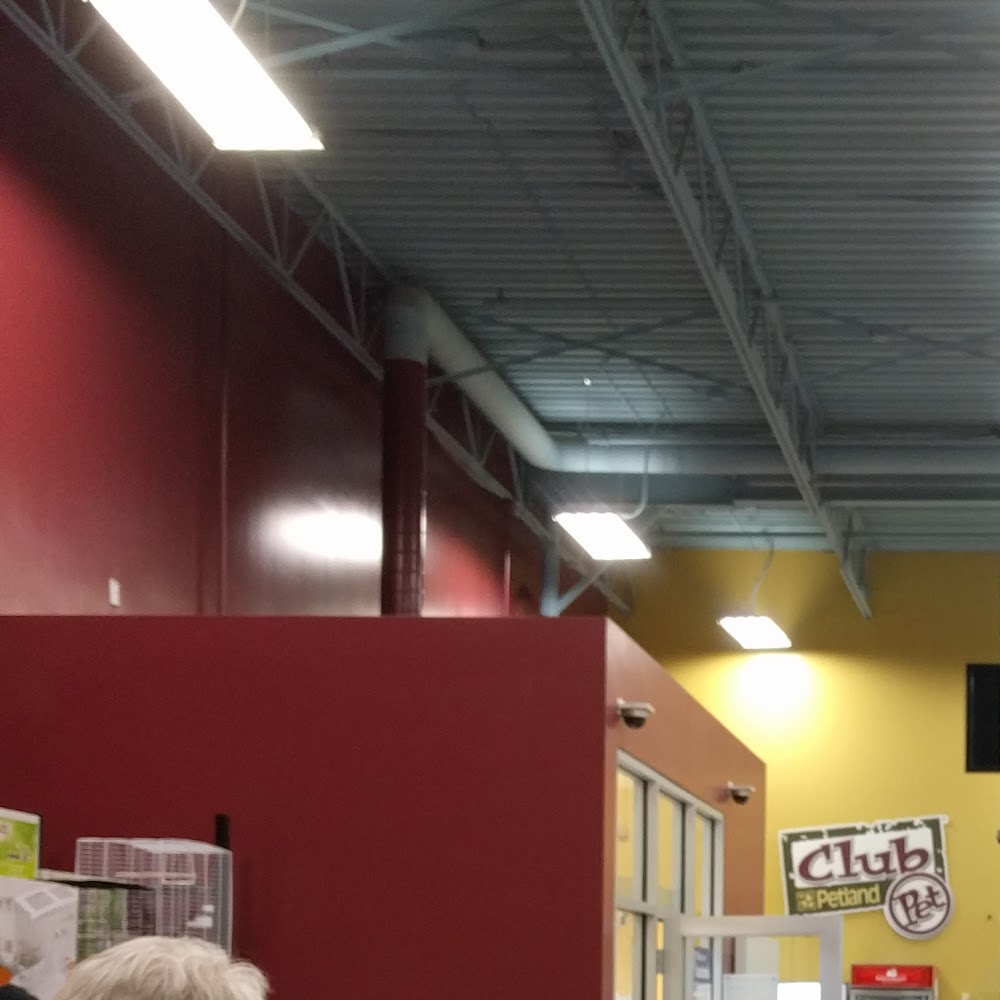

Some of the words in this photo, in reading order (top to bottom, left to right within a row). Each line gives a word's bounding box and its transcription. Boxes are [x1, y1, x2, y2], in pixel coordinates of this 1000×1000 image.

[798, 836, 929, 881] Club
[816, 884, 881, 908] Petland
[893, 885, 946, 927] Pet
